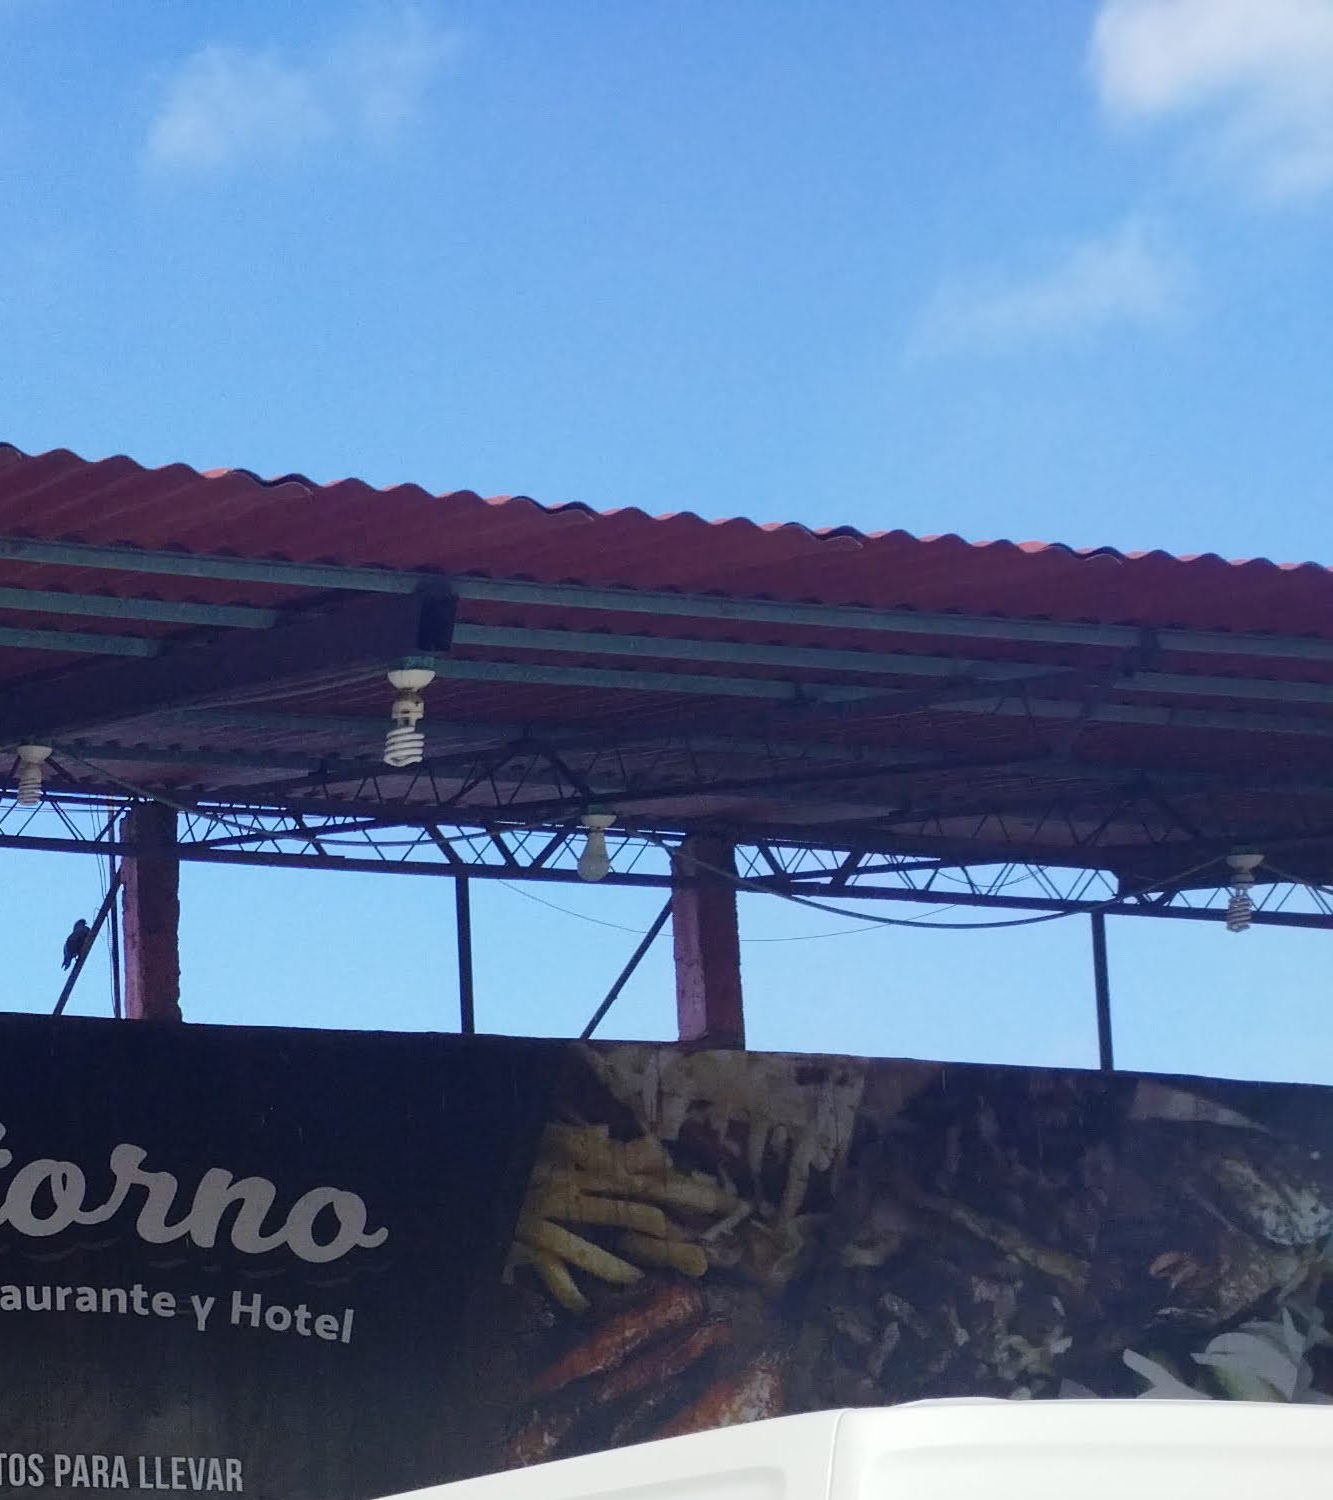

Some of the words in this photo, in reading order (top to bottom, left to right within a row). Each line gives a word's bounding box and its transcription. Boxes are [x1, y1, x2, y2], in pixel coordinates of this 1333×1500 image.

[191, 1293, 217, 1332] y
[230, 1291, 355, 1344] Hotel
[54, 1453, 131, 1490] PARA
[138, 1455, 245, 1493] LLEVAR
